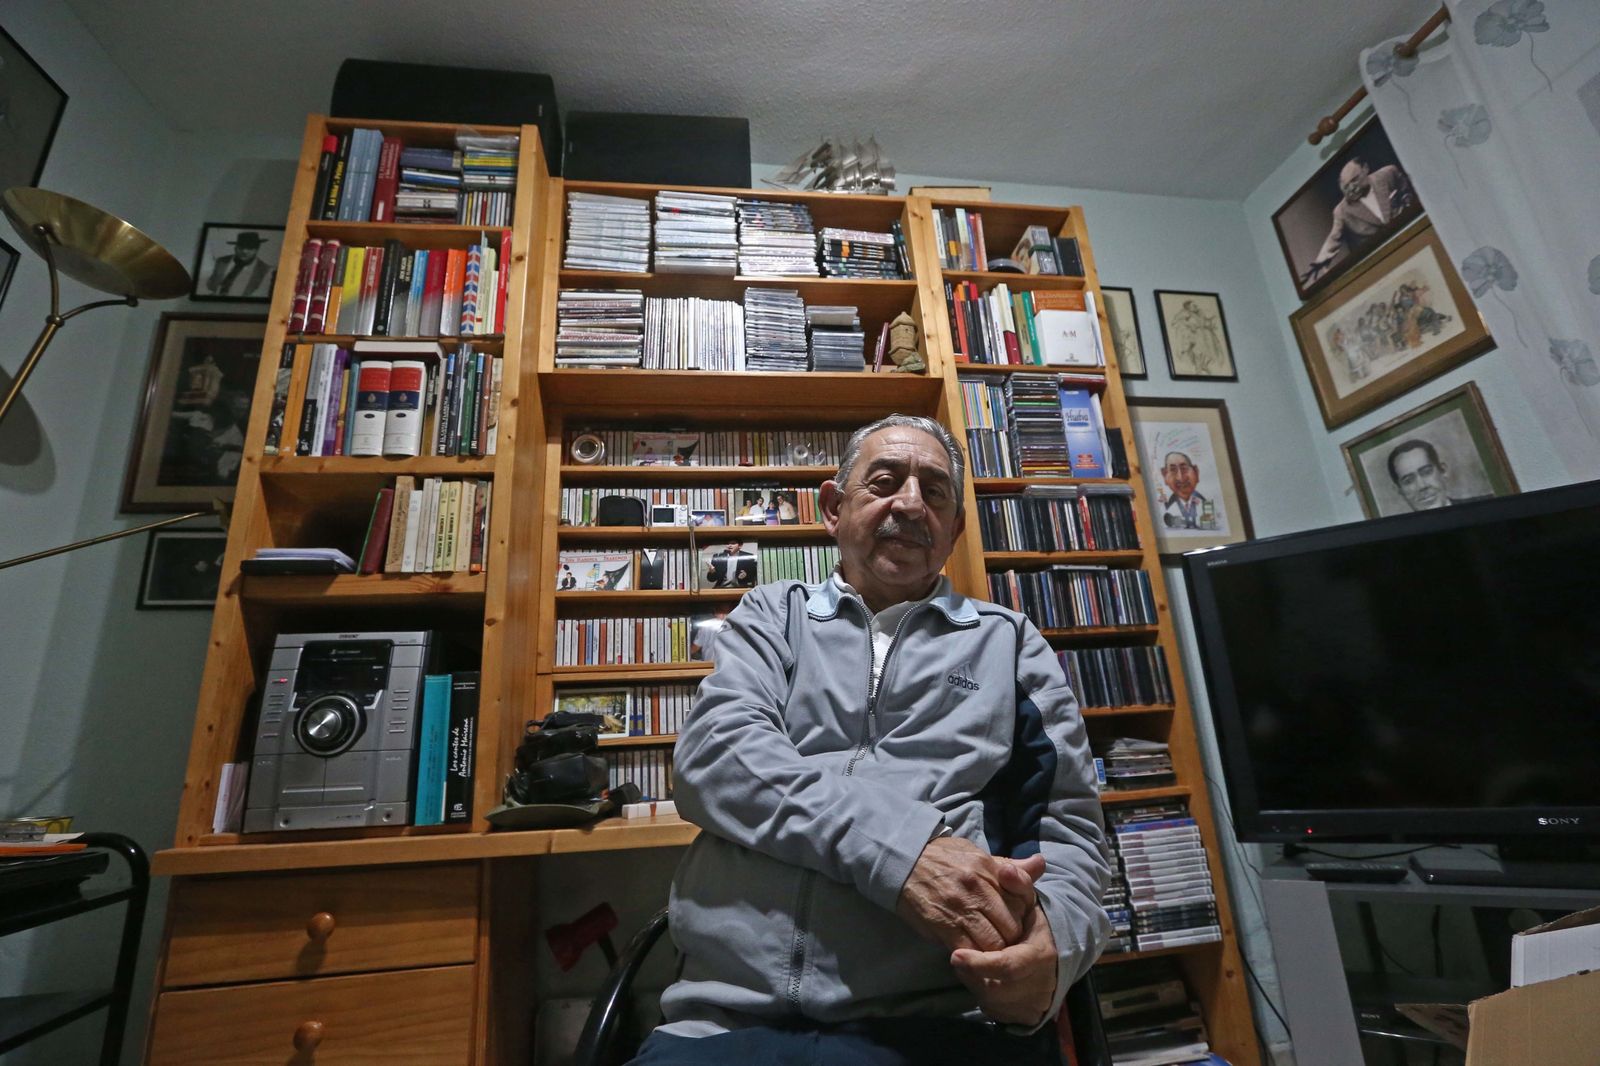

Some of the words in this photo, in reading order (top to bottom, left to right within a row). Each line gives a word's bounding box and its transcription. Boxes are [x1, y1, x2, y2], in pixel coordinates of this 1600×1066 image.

[947, 674, 980, 691] adidas
[452, 727, 459, 736] de
[460, 718, 469, 747] Mairena
[450, 760, 458, 772] Los
[458, 749, 467, 777] Antonio
[1538, 817, 1580, 826] SONY
